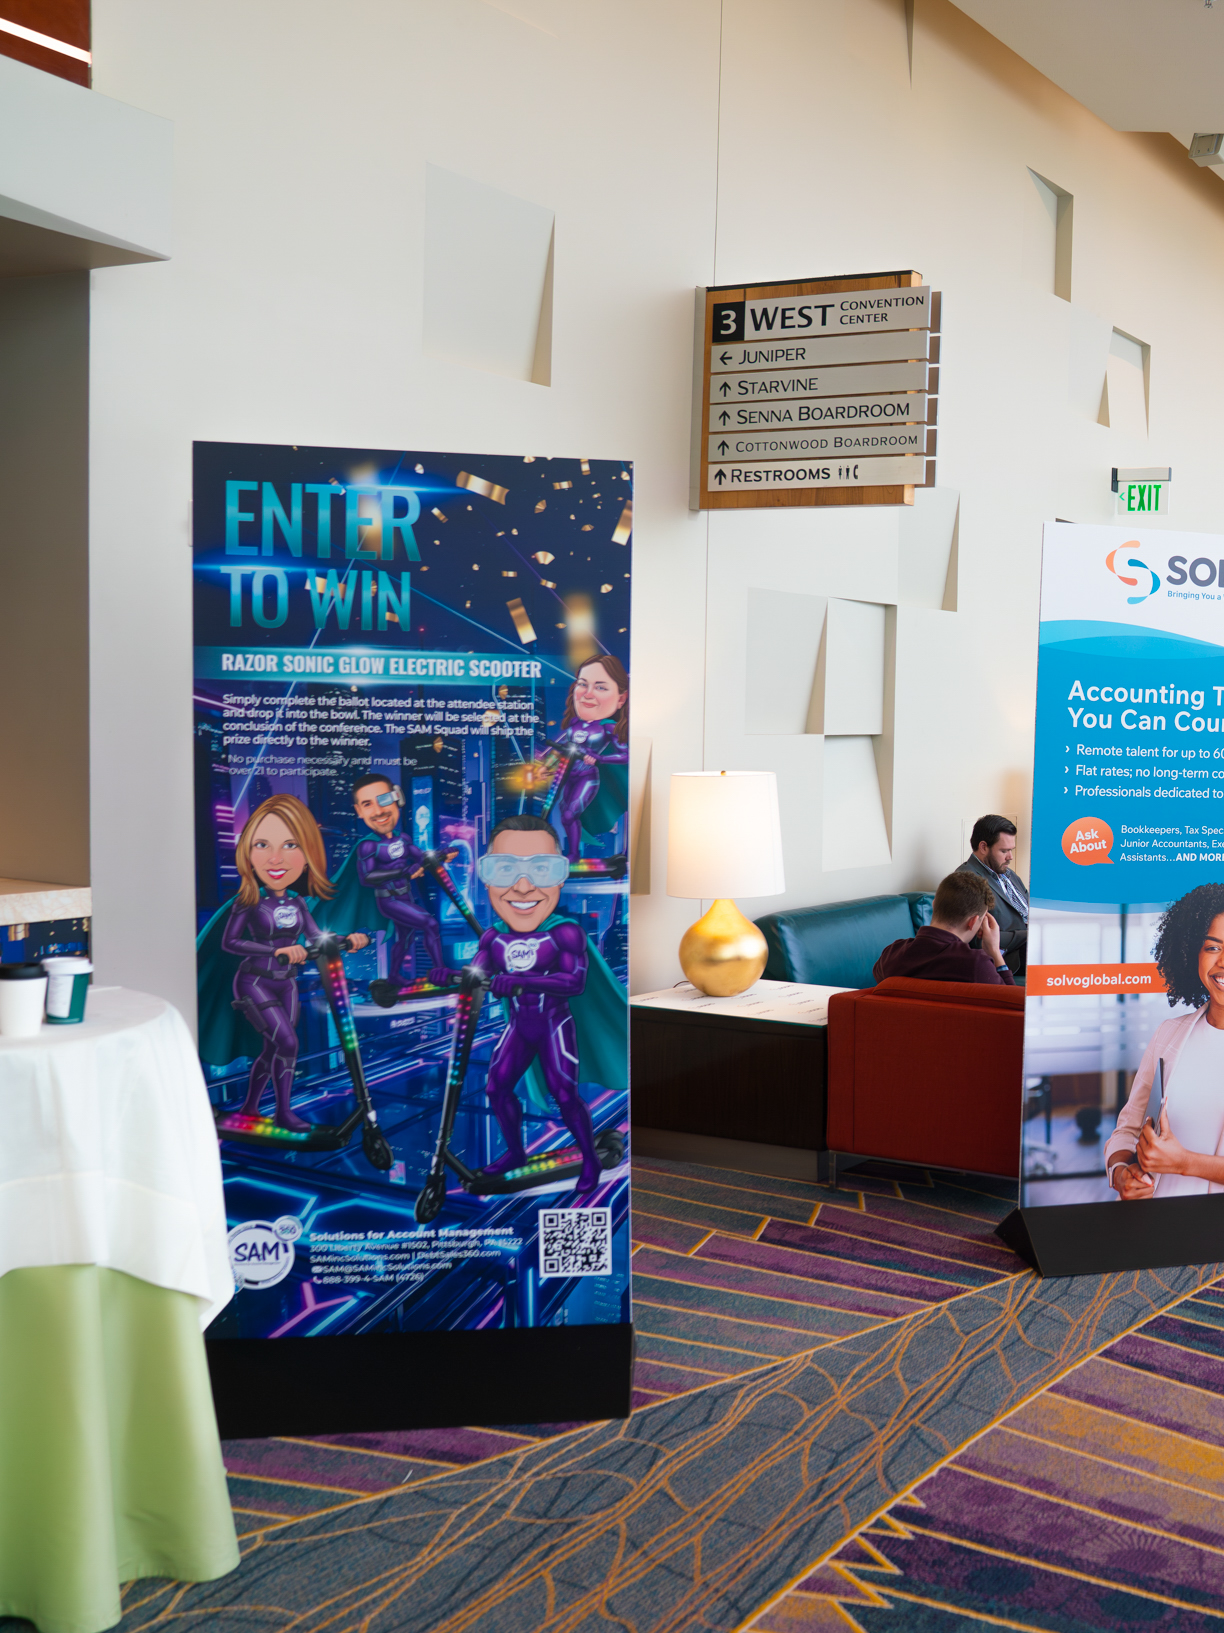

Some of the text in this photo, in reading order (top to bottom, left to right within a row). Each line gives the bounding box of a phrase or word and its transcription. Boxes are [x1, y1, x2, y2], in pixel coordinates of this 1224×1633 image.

[719, 296, 925, 335] 3 WEST CONVENTION
[839, 312, 889, 326] CENTER
[738, 347, 807, 365] JUNIPER
[737, 377, 819, 396] STARVINE
[736, 403, 910, 425] SENNA BOARDROOM
[735, 435, 918, 453] COTTONWOOD BOARDROOM
[730, 468, 831, 483] RESTROOMS
[1127, 484, 1162, 512] EXIT
[225, 480, 422, 562] ENTER
[219, 566, 411, 632] TO WIN
[1167, 590, 1200, 601] Bringing
[1201, 592, 1216, 601] You
[221, 653, 542, 679] RAZOR SONIC GLOW ELECTRIC SCOOTER
[222, 693, 534, 710] Simply complete the ballot located at the attendee station
[1068, 680, 1205, 711] Accounting
[222, 707, 540, 724] and drop it into the bowl. The winner will be selected at the
[1067, 706, 1112, 729] You
[1120, 708, 1166, 731] Can
[222, 721, 535, 738] conclusion of the conference. The SAM Squad will ship the
[222, 734, 372, 748] prize directly to the winner.
[227, 754, 418, 767] No purchase necessary and must be
[1076, 744, 1123, 757] Remote
[1125, 745, 1160, 758] talent
[1161, 746, 1179, 758] for
[1181, 748, 1195, 761] up
[1198, 749, 1210, 759] to
[228, 766, 340, 778] over 21 to participate.
[1075, 764, 1098, 776] Flat
[1100, 766, 1133, 779] rates;
[1135, 768, 1150, 778] no
[1153, 766, 1209, 781] long-term
[1075, 785, 1151, 798] Professionals
[1153, 786, 1210, 799] dedicated
[1212, 789, 1224, 799] to
[1075, 828, 1099, 842] Ask
[1121, 824, 1183, 836] Bookkeepers,
[1184, 825, 1200, 835] Tax
[1069, 839, 1107, 854] About
[1120, 838, 1150, 849] Junior
[1151, 839, 1210, 850] Accountants,
[1046, 973, 1152, 989] solvoglobal.com
[309, 1230, 366, 1243] Solutions
[366, 1230, 386, 1240] for
[386, 1229, 437, 1240] Account
[437, 1226, 515, 1239] Management
[234, 1241, 280, 1262] SAM
